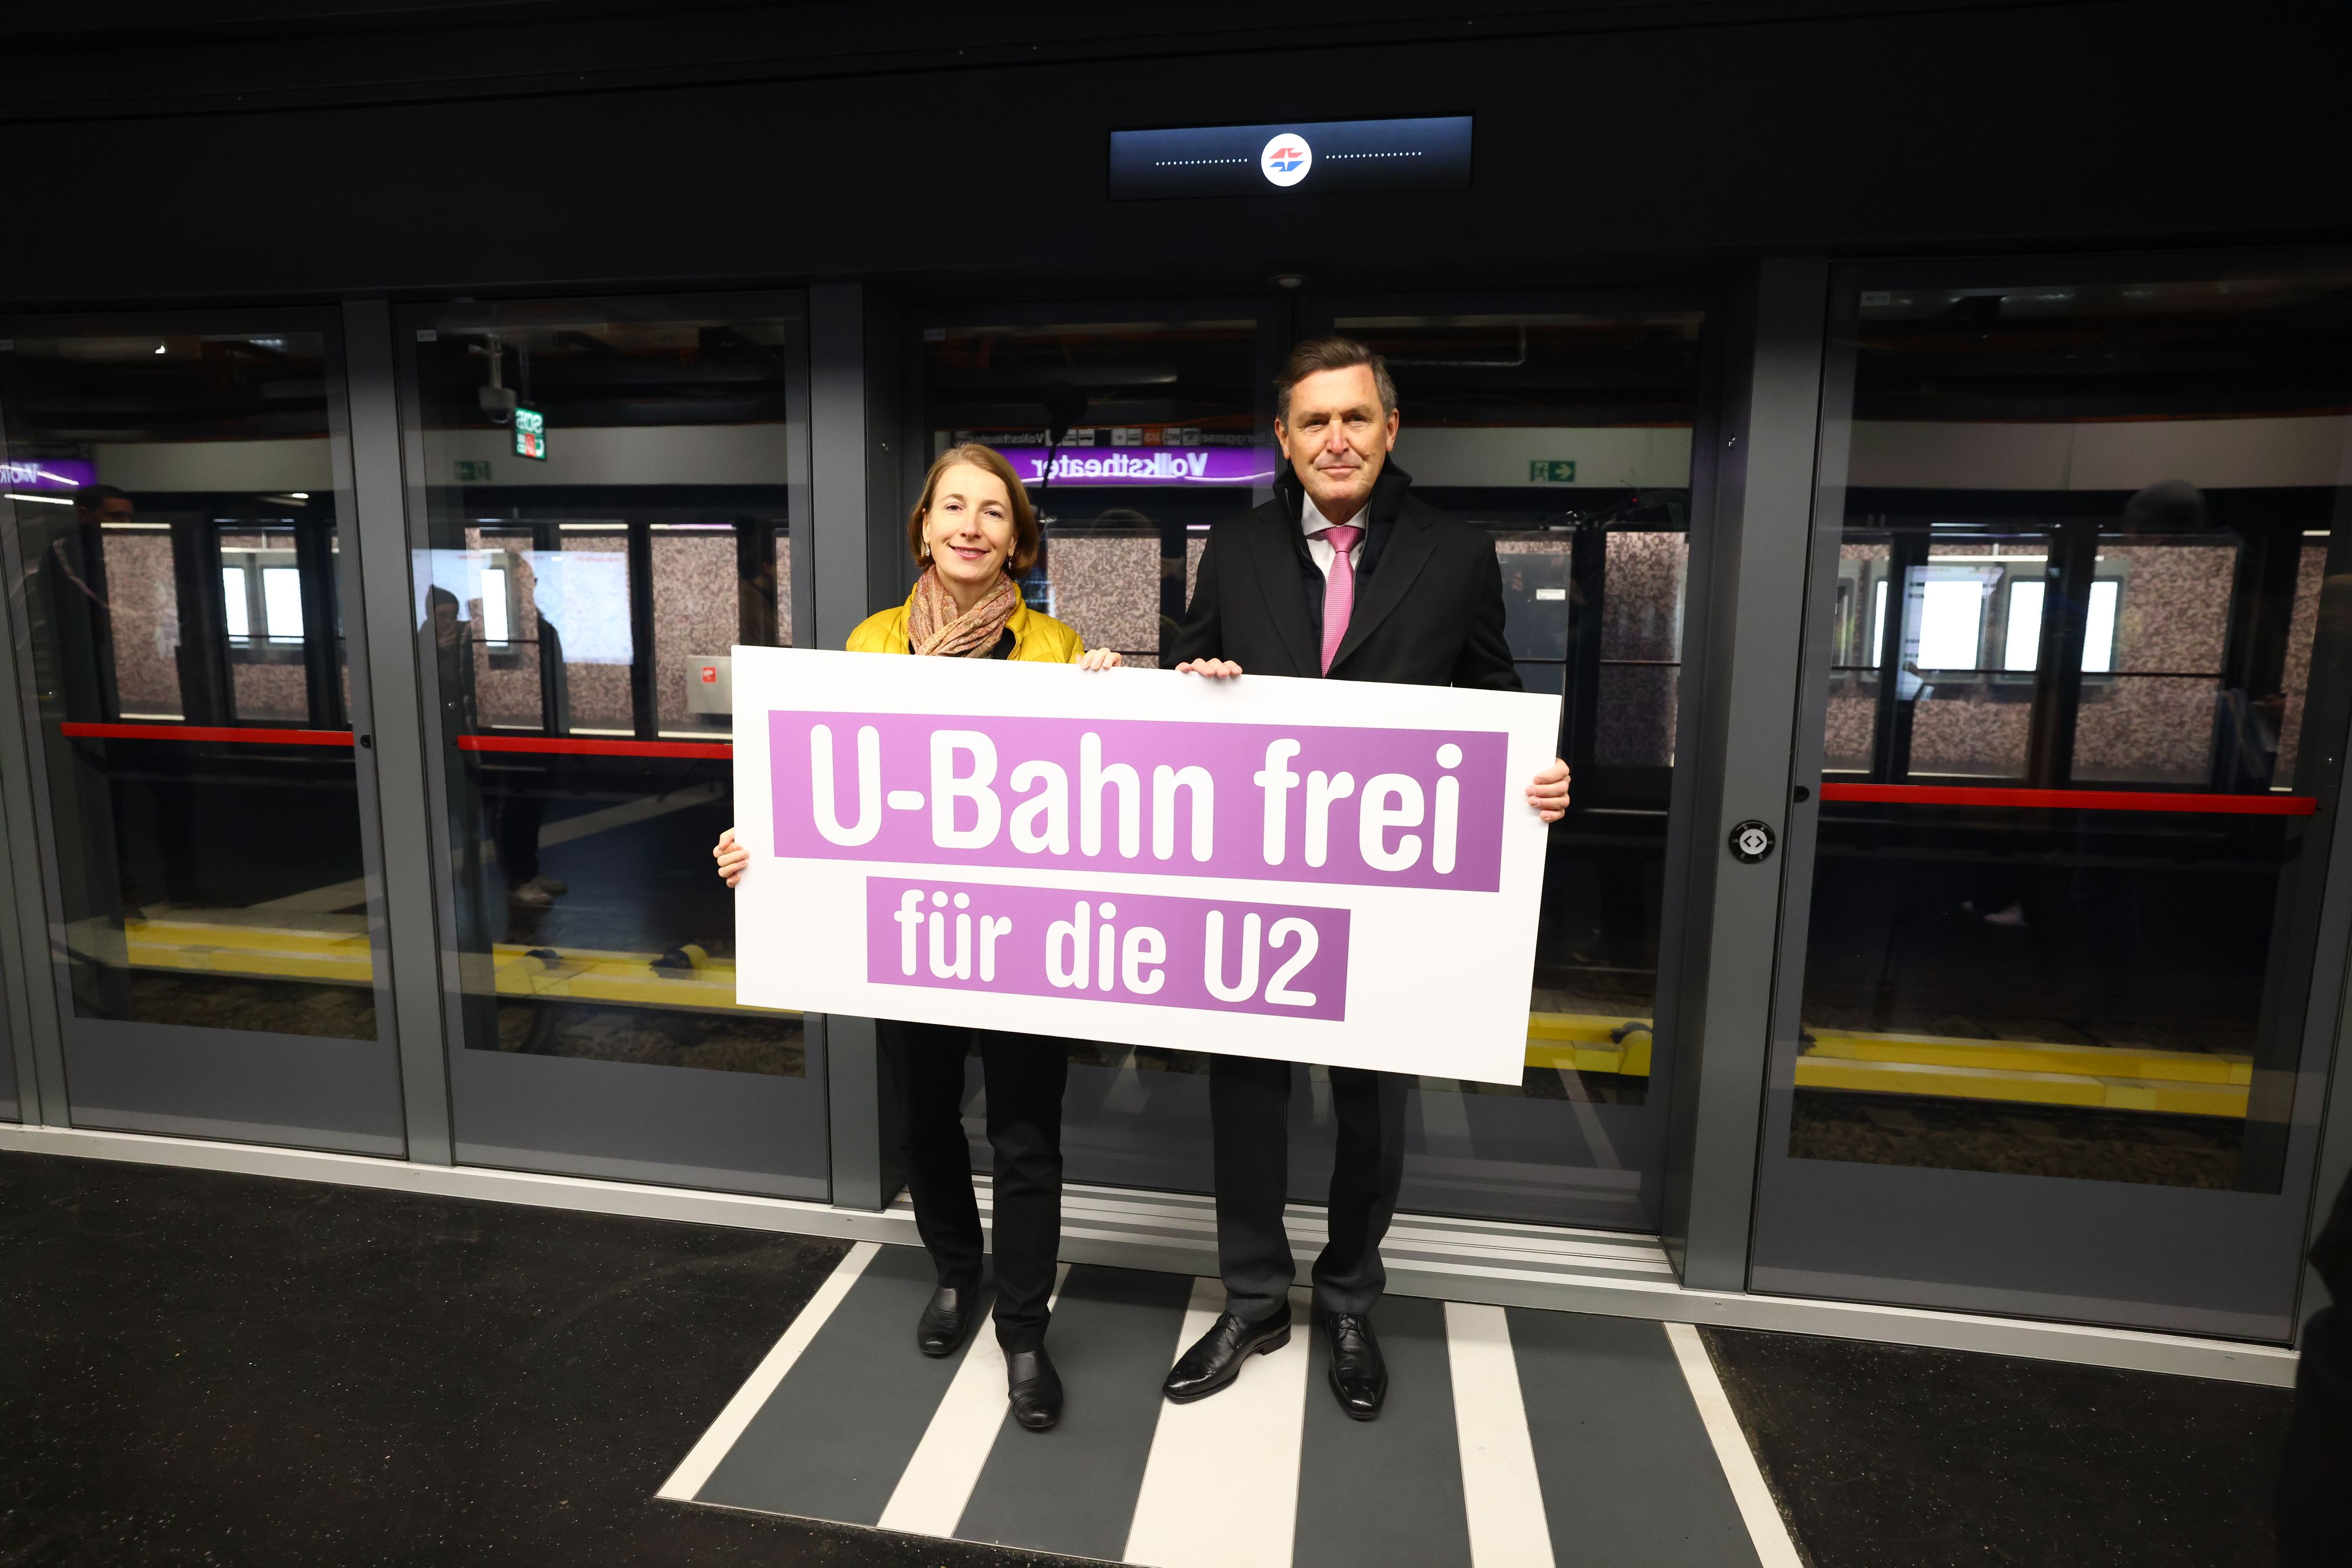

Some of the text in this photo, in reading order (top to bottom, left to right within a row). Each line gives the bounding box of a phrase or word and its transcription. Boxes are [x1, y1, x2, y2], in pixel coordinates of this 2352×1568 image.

[811, 724, 1462, 874] U-Bahn frei
[894, 890, 1318, 1006] für die U2
